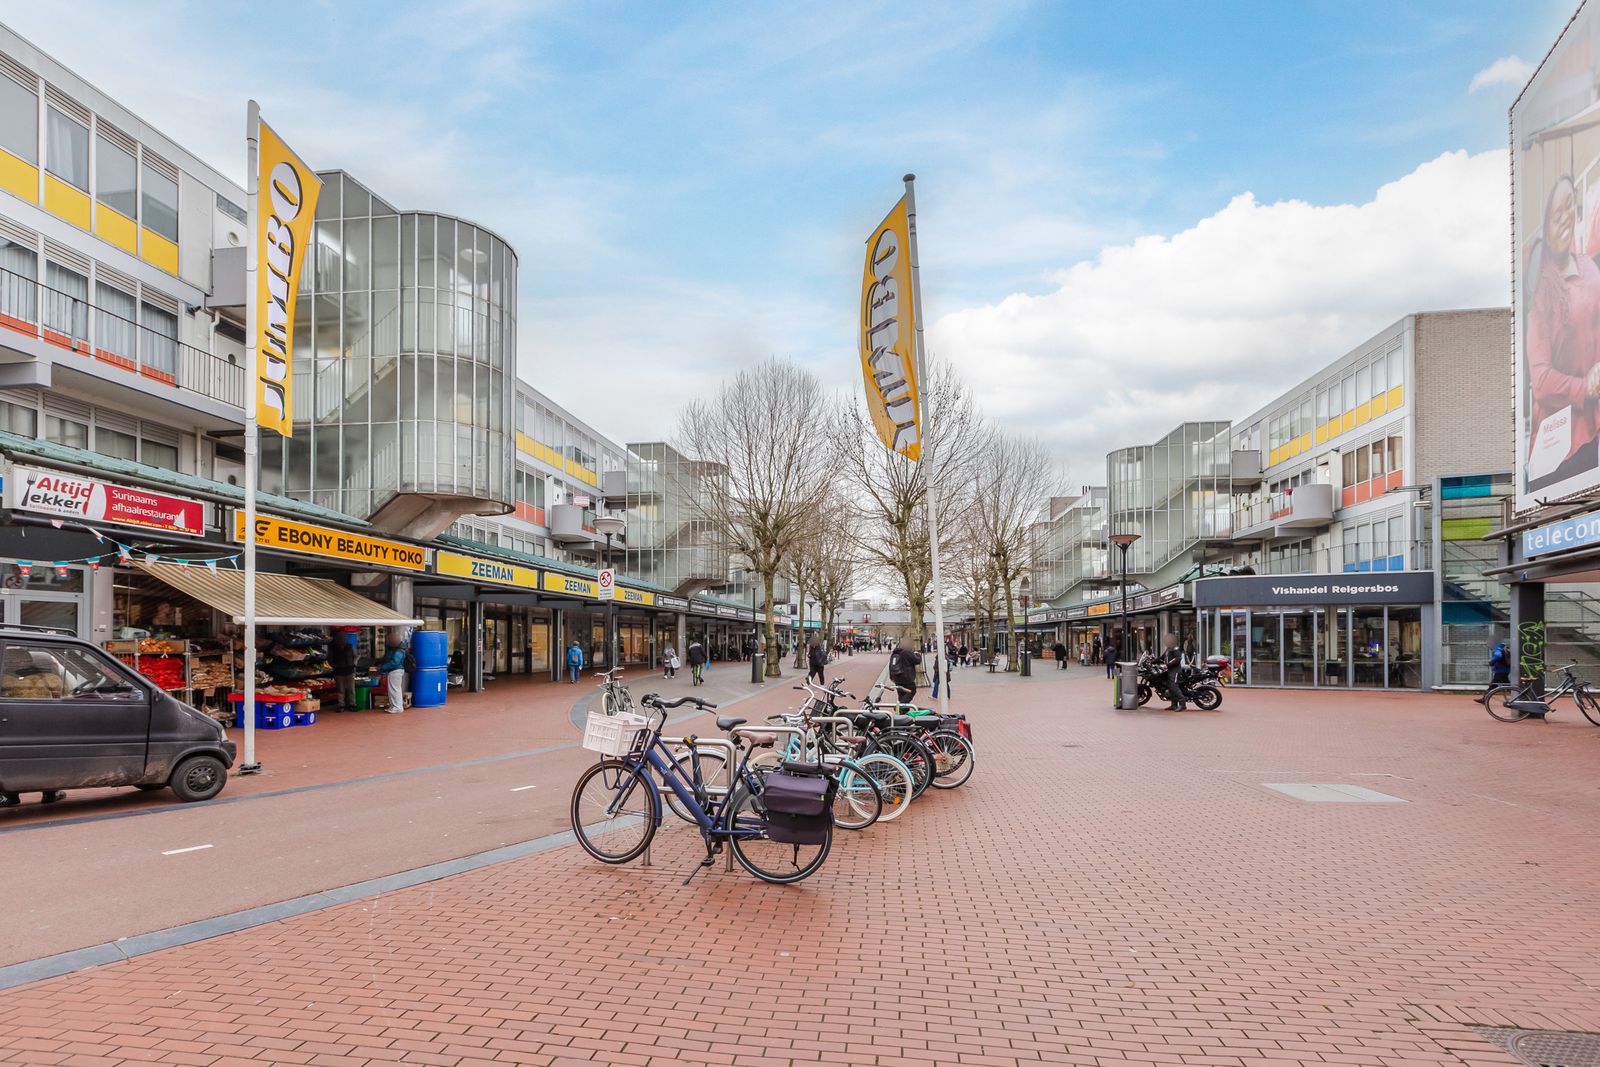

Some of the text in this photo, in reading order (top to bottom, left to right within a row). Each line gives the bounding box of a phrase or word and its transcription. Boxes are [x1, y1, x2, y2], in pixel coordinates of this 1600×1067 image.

[259, 161, 303, 422] JUMBO
[37, 477, 95, 501] Altijd
[112, 490, 158, 506] Surinaams
[278, 527, 333, 549] EBONY
[337, 537, 389, 560] BEAUTY
[392, 548, 423, 565] TOKO
[471, 561, 514, 582] ZEEMAN
[564, 579, 591, 594] ZEEMAN
[1272, 584, 1399, 595] Vishandel Reigersbos
[624, 590, 643, 602] ZEEMAN
